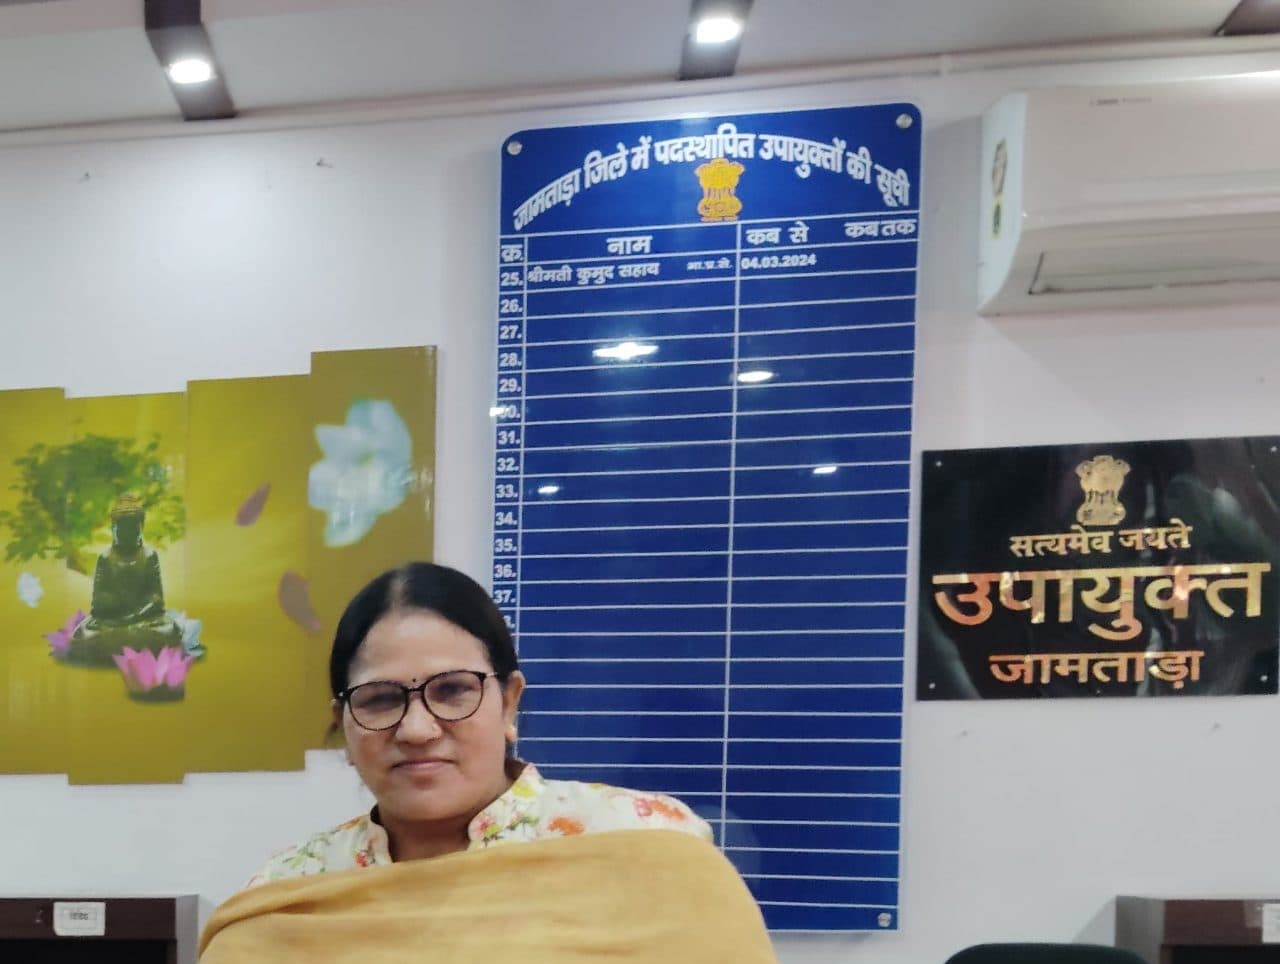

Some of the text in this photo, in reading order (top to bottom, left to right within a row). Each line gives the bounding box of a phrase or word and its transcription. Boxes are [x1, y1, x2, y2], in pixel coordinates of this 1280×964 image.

[513, 123, 911, 231] जामताड़ा जिले में पदस्थापित उपायुक्तों की सूची
[746, 221, 809, 245] कब से
[606, 235, 653, 255] नाम
[741, 253, 816, 270] 04.03.2024
[501, 272, 523, 286] 25.
[527, 265, 573, 283] श्रीमती
[576, 266, 615, 285] कुमुद
[618, 262, 660, 278] सहाय
[500, 299, 522, 313] 26.
[500, 325, 522, 339] 27.
[499, 353, 522, 367] 28.
[499, 378, 522, 393] 29.
[498, 431, 520, 445] 31.
[497, 457, 519, 471] 32.
[496, 484, 518, 498] 33.
[496, 512, 517, 526] 34.
[495, 539, 517, 552] 35.
[1010, 519, 1193, 558] सत्यमेव जयते
[494, 564, 516, 578] 36.
[494, 590, 516, 604] 37.
[932, 562, 1272, 641] उपायुक्त
[989, 650, 1205, 690] जामताड़ा
